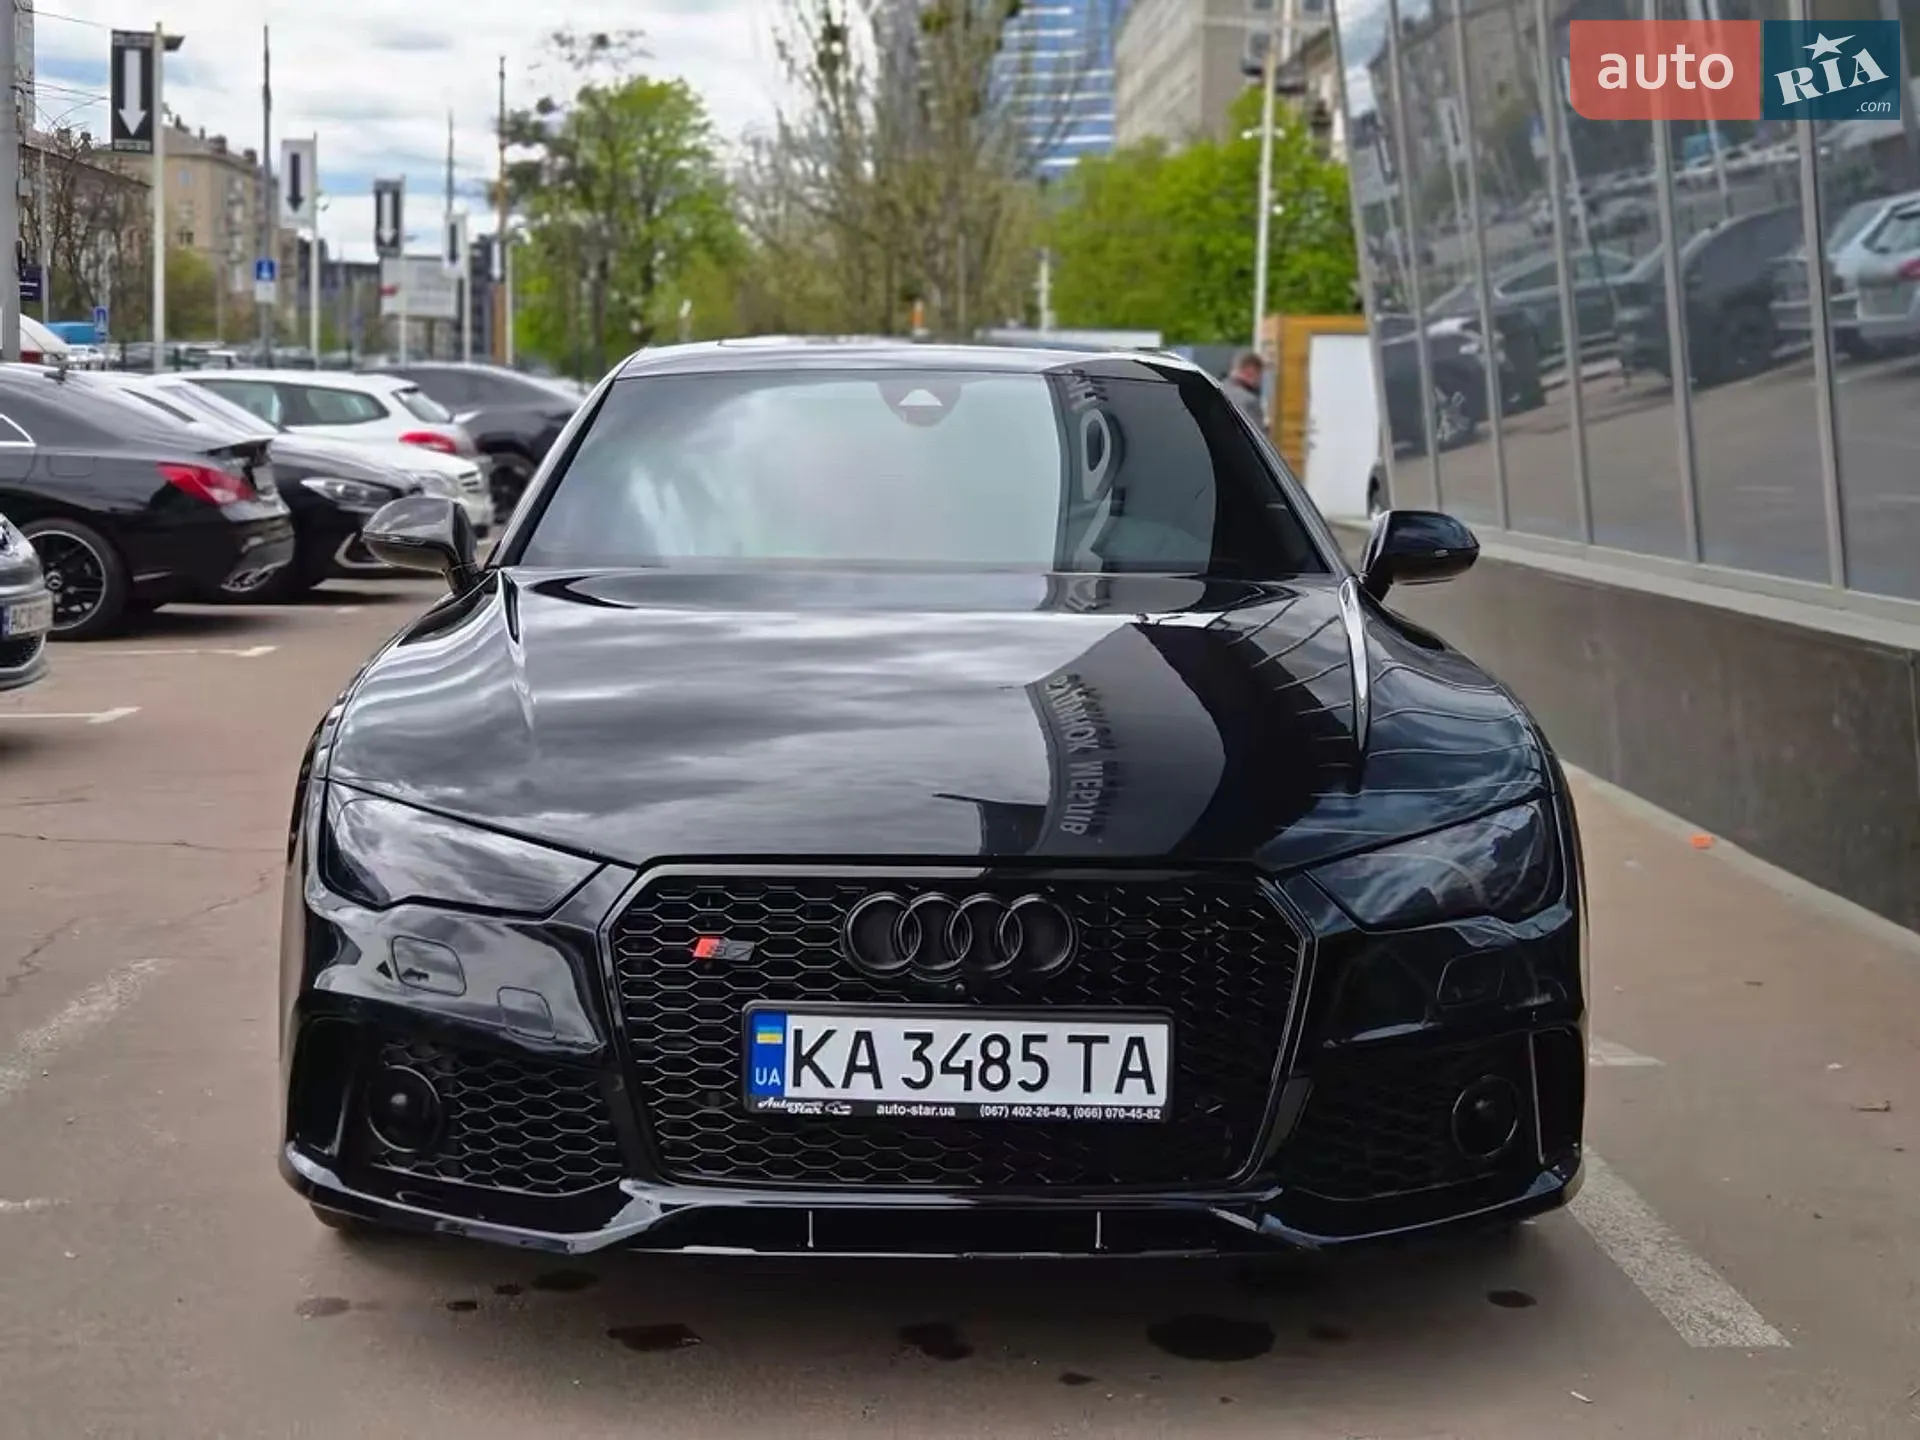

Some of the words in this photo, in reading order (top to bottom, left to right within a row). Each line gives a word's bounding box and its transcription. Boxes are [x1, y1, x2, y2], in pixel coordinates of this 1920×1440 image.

[791, 1028, 884, 1090] KA
[900, 1031, 1050, 1093] 3485
[1066, 1034, 1157, 1096] TA
[755, 1068, 782, 1087] UA
[876, 1103, 956, 1117] auto-star.ua
